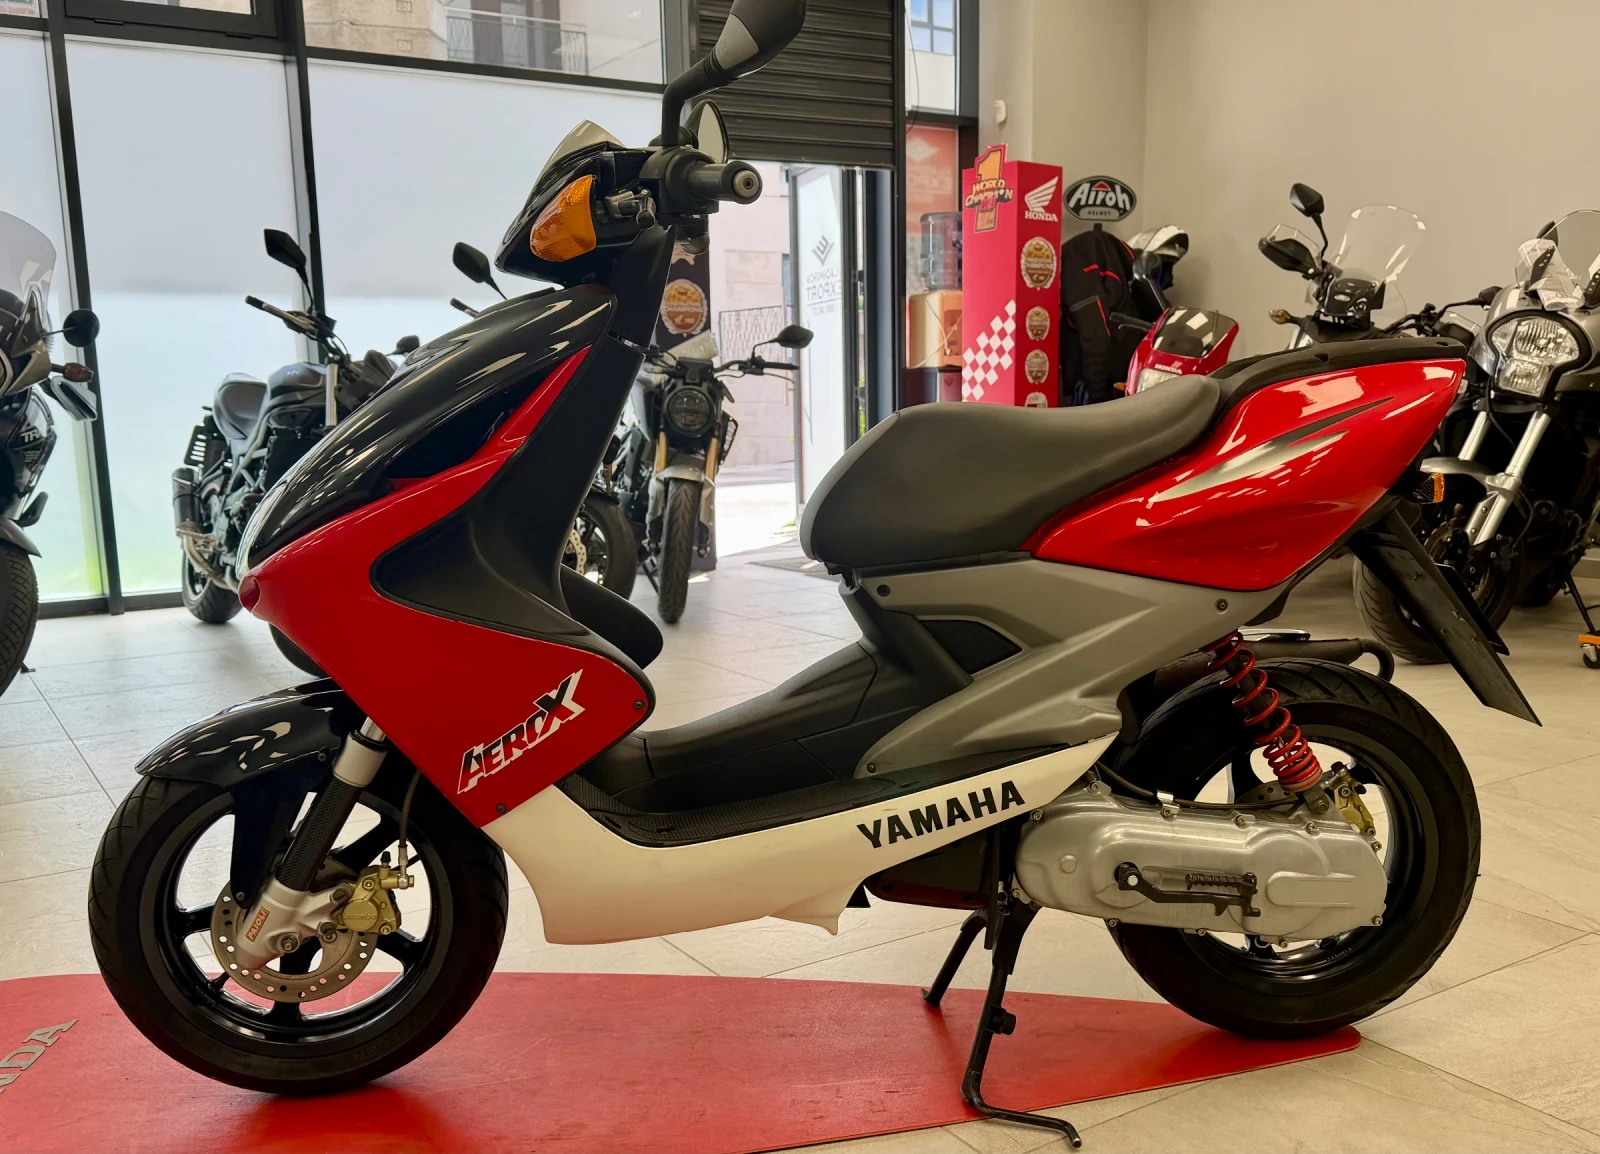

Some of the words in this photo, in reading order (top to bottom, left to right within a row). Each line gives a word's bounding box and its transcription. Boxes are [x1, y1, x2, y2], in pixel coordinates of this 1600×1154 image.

[972, 179, 1006, 195] WORLD
[1068, 182, 1131, 211] Airoh
[1024, 210, 1059, 222] HONDA
[1154, 363, 1183, 375] HONDA
[457, 668, 586, 794] AEROX
[856, 780, 1026, 849] YAMAHA
[247, 908, 269, 940] PAIOLI
